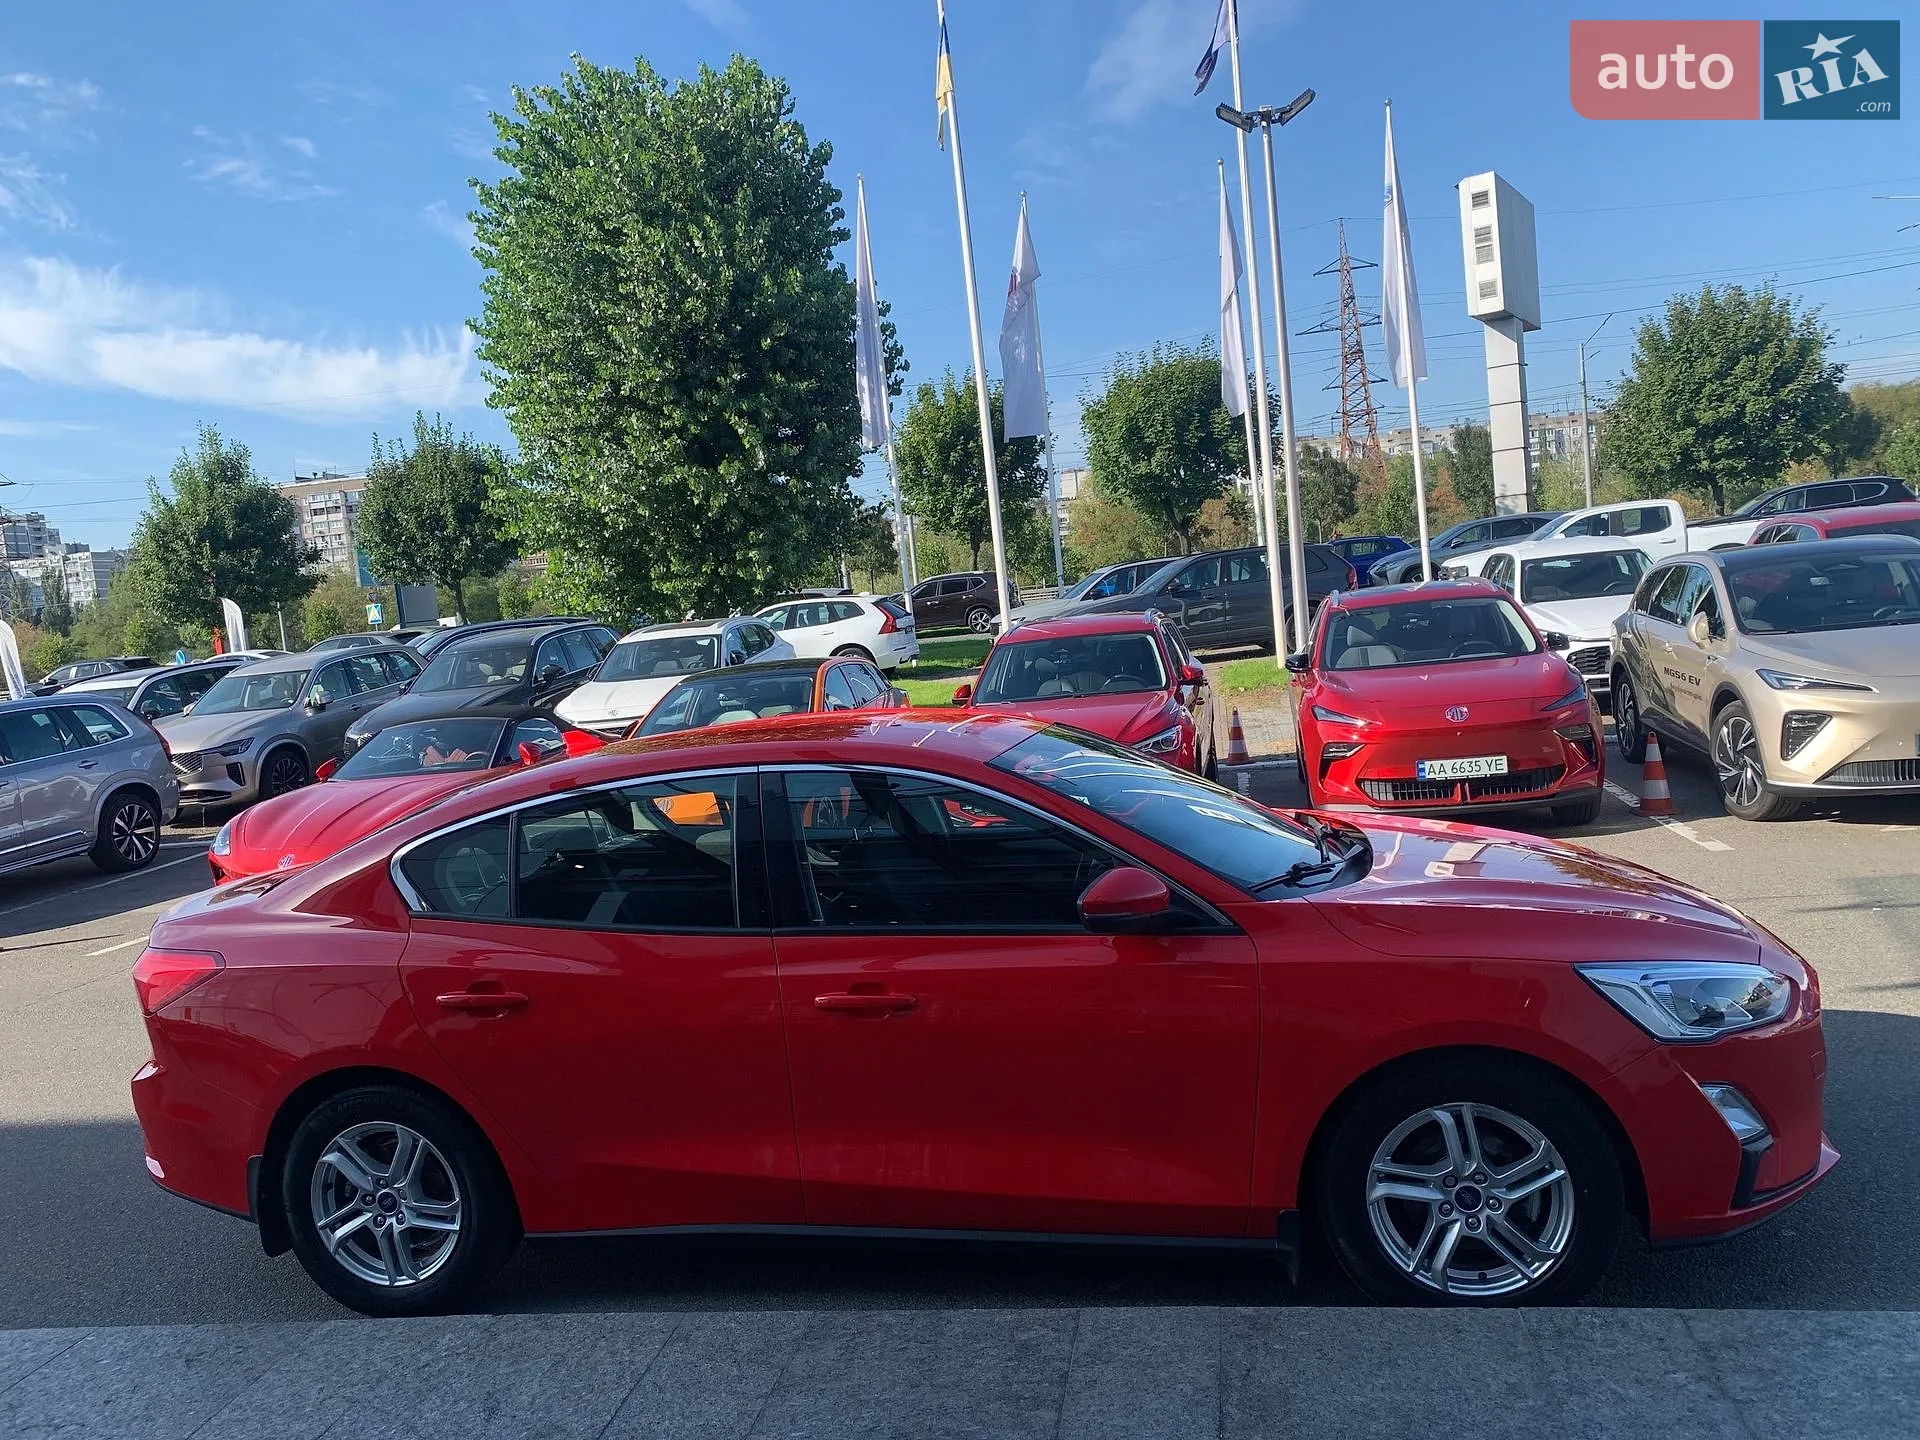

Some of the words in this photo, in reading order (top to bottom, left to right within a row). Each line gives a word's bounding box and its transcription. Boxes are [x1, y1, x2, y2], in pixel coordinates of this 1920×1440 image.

[1663, 666, 1687, 681] MGS6
[1688, 674, 1701, 686] EV
[1427, 763, 1447, 776] AA
[1451, 760, 1481, 774] 6635
[1485, 758, 1504, 772] YE
